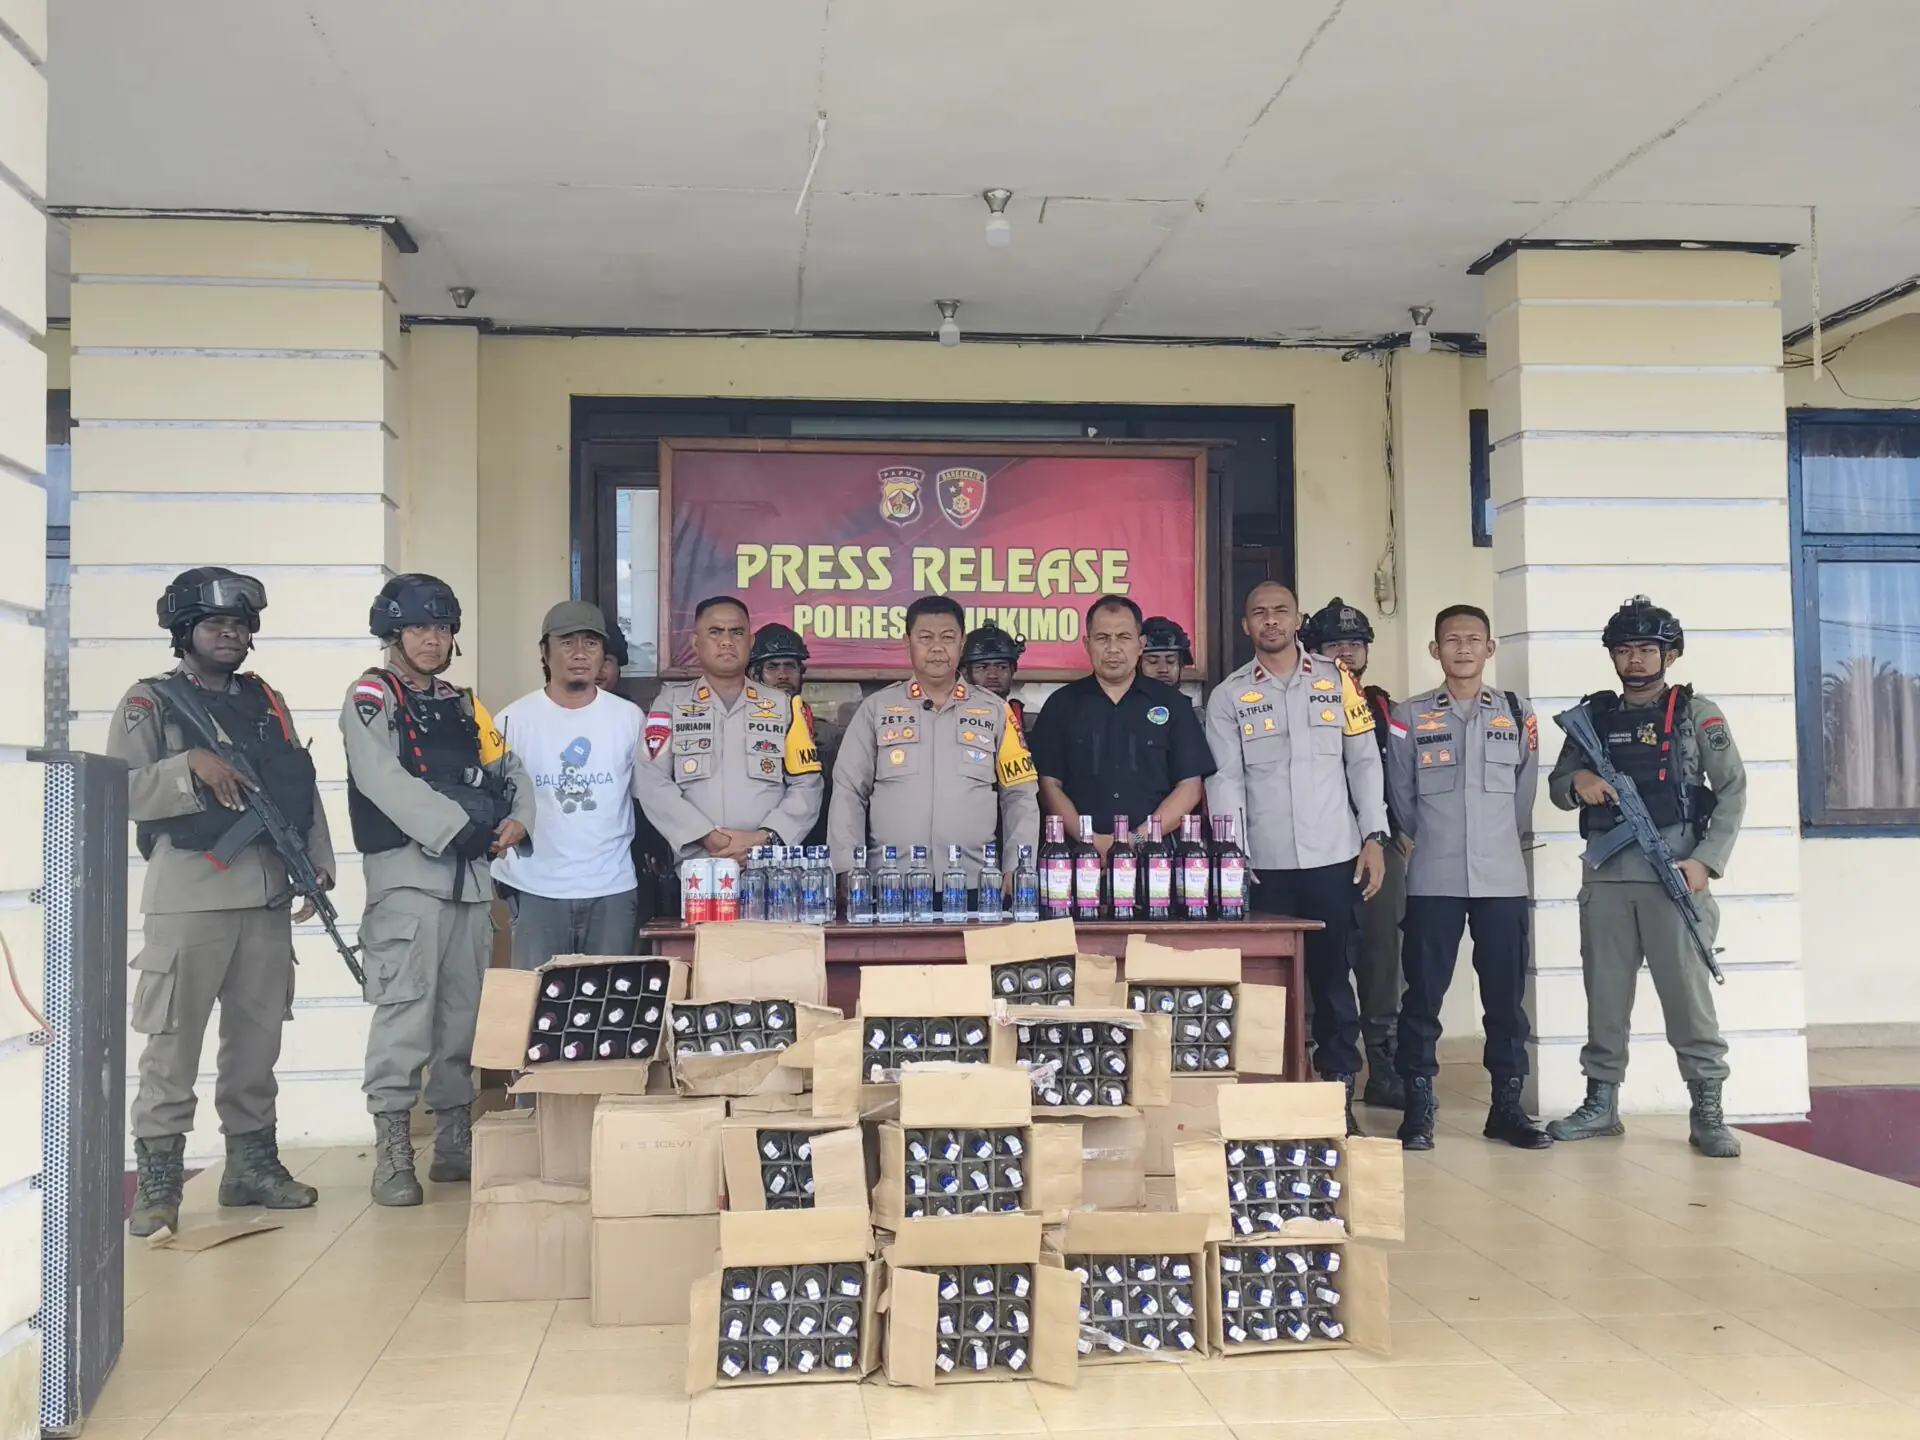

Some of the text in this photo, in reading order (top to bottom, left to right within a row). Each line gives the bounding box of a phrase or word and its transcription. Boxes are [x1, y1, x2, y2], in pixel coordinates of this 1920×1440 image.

[735, 543, 1131, 599] PRESS RELEASE
[793, 603, 908, 641] POLRES
[1309, 695, 1342, 704] POLRI
[748, 722, 784, 734] POLRI
[959, 717, 995, 732] POLRI
[1486, 731, 1518, 741] POLRI
